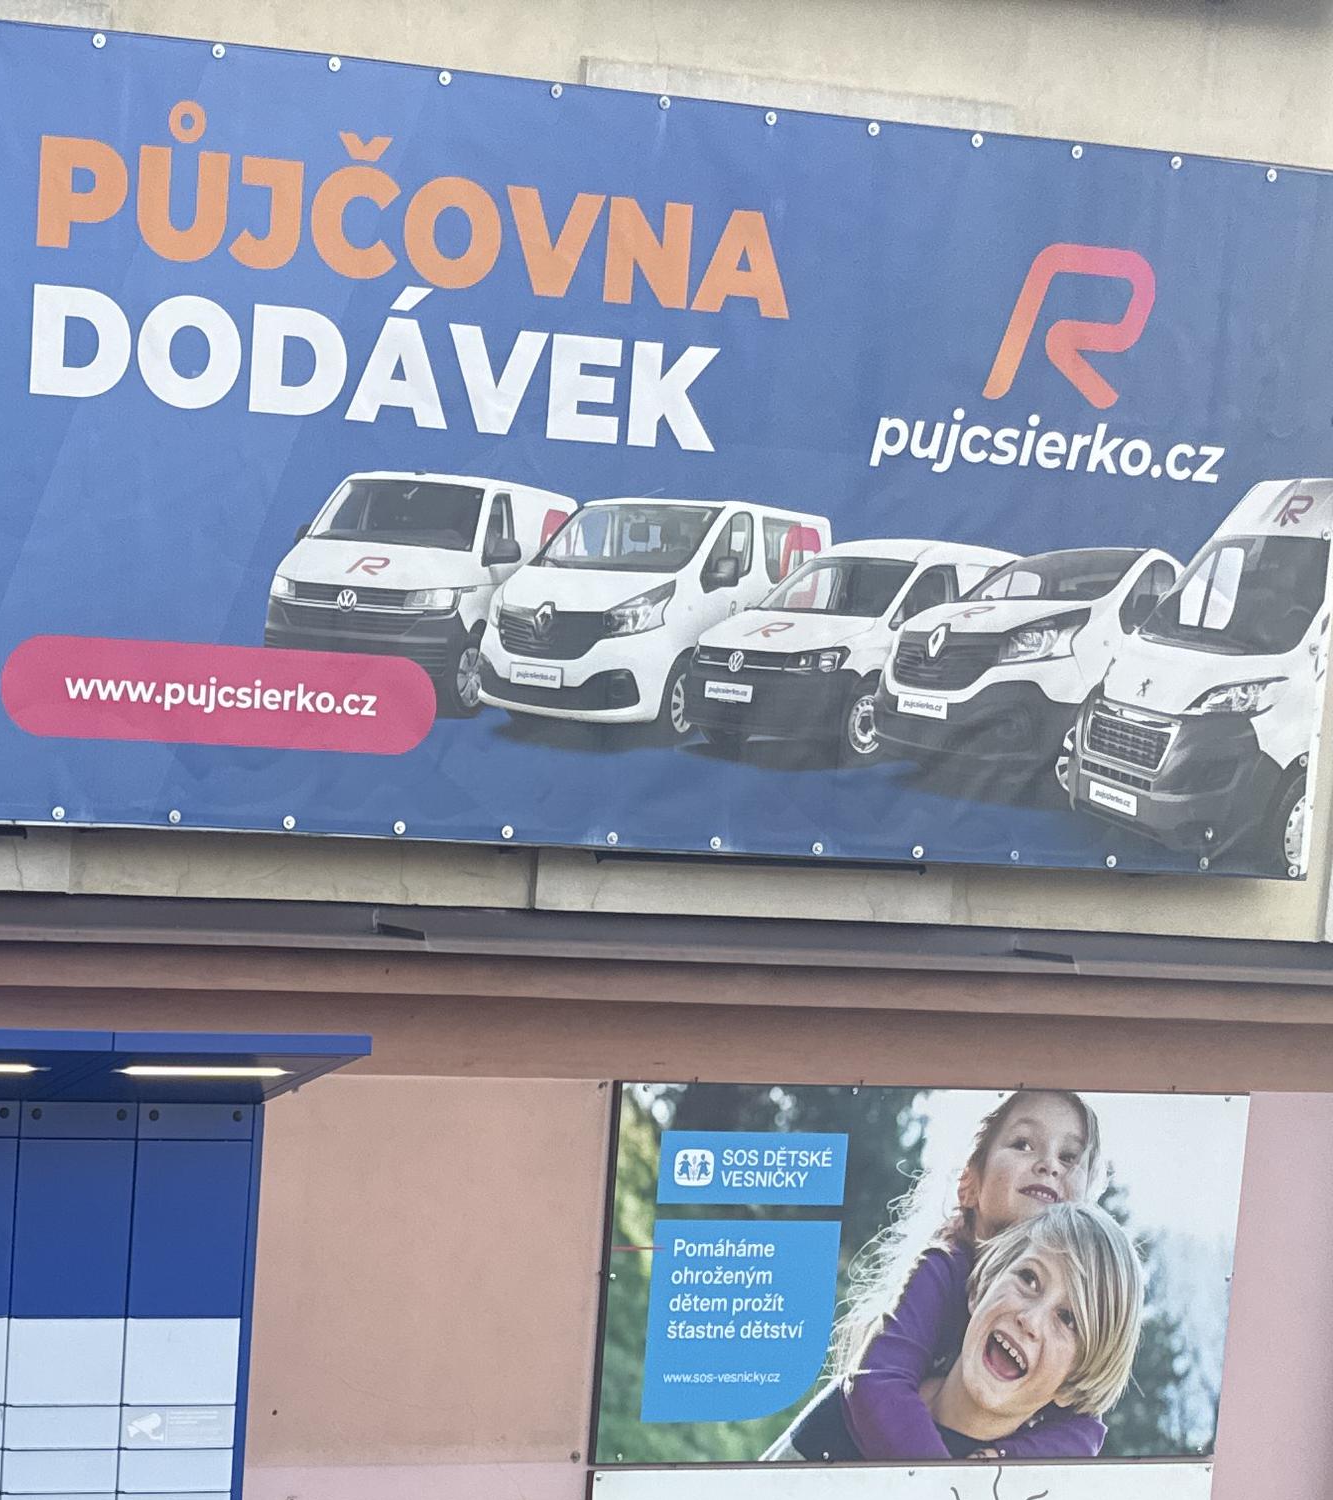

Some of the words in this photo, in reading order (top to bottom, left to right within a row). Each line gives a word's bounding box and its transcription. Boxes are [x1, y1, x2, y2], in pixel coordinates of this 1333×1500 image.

[34, 99, 791, 322] PŮJČOVNA
[27, 283, 722, 455] DODÁVEK
[867, 408, 1226, 486] pujcsierko.cz
[64, 667, 378, 719] www.pujcsierko.cz
[721, 1149, 760, 1168] SOS
[763, 1147, 833, 1169] DĚTSKÉ
[720, 1165, 809, 1189] VESNIČKY
[673, 1237, 776, 1259] Pomáháme
[671, 1263, 774, 1288] ohroženým
[669, 1289, 729, 1312] dětem
[731, 1291, 784, 1317] prožít
[667, 1317, 736, 1340] šťastné
[739, 1317, 805, 1340] dětství
[663, 1369, 781, 1386] www.sos-vesnicky.cz
